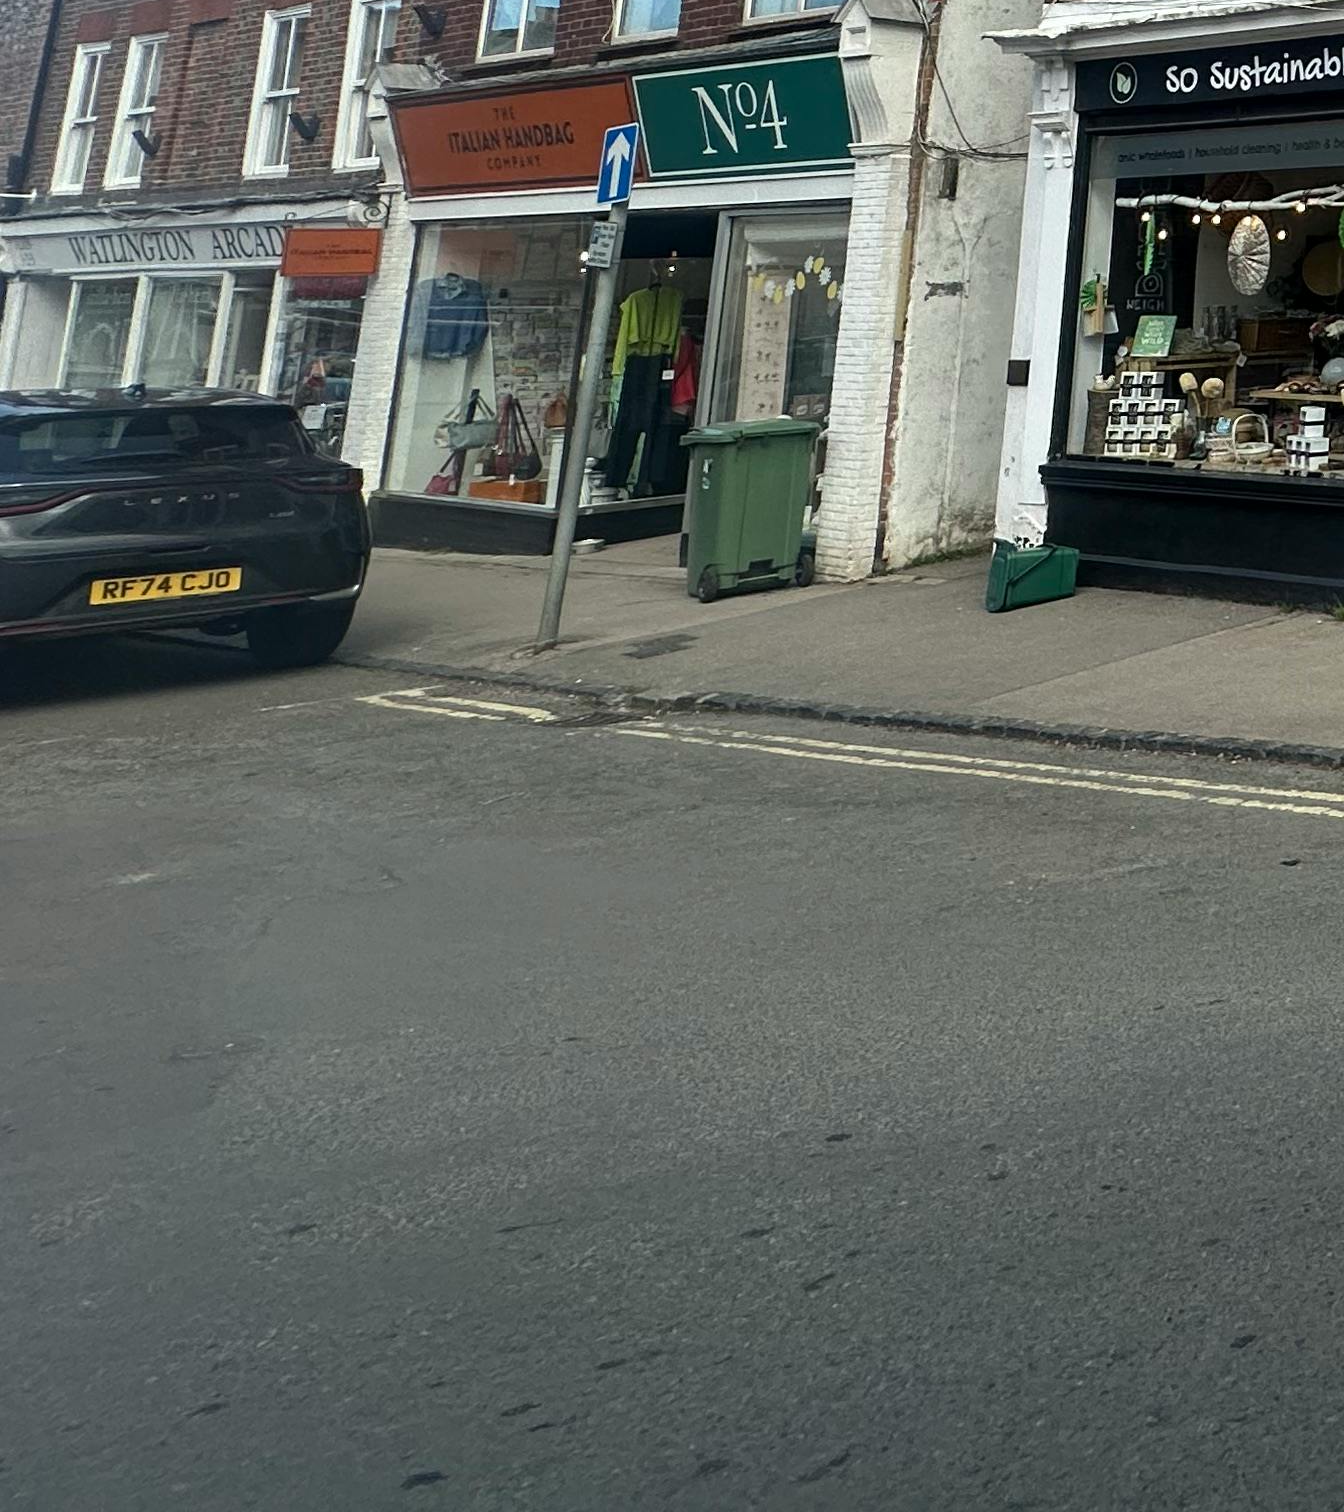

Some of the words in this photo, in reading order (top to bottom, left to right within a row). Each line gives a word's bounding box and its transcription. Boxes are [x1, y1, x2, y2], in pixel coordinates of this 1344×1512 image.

[1165, 64, 1198, 93] So
[493, 105, 515, 121] THE
[449, 127, 500, 154] ITALIAN
[502, 121, 575, 149] HANDBAG
[486, 154, 541, 170] COMPANY
[67, 230, 196, 264] WATLINGTON
[211, 225, 286, 259] ARCAD
[102, 574, 171, 600] RF74
